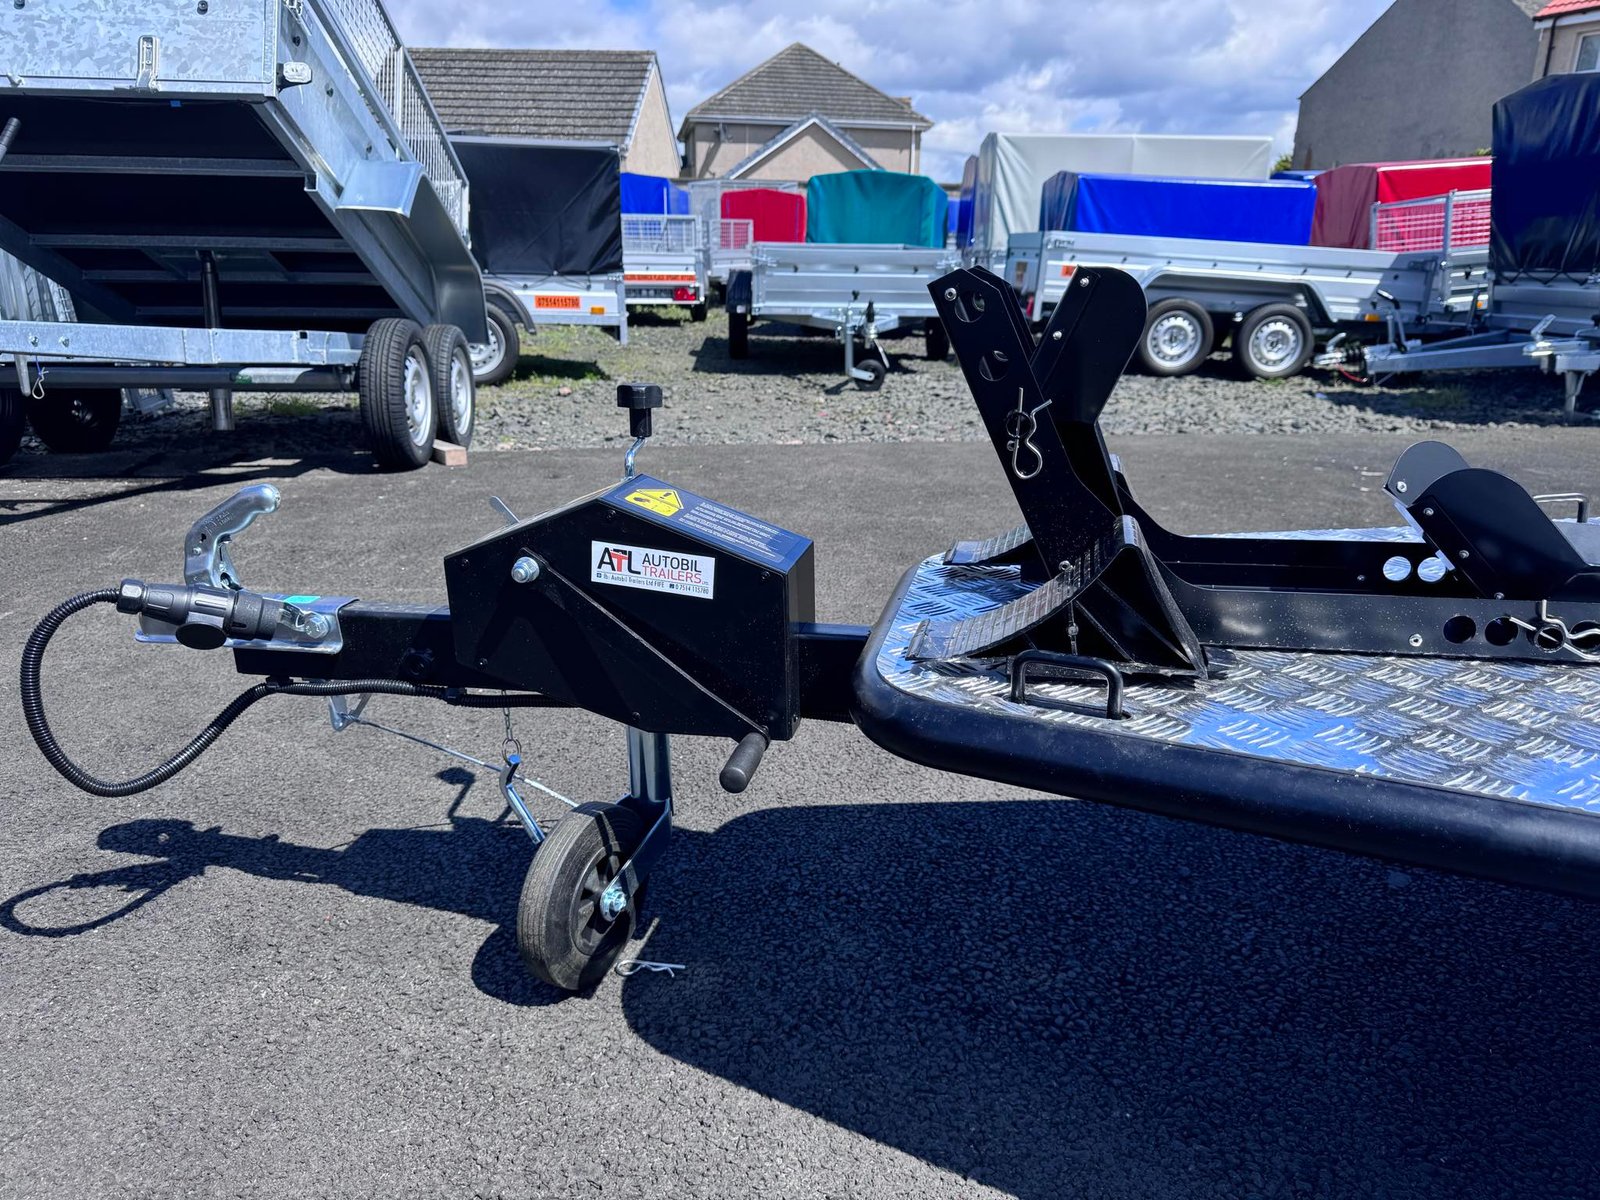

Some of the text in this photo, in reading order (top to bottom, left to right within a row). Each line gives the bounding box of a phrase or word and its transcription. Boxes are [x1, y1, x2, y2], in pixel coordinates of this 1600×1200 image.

[597, 547, 641, 575] ATL
[642, 553, 701, 573] AUTOBIL
[642, 565, 702, 584] TRAILERS
